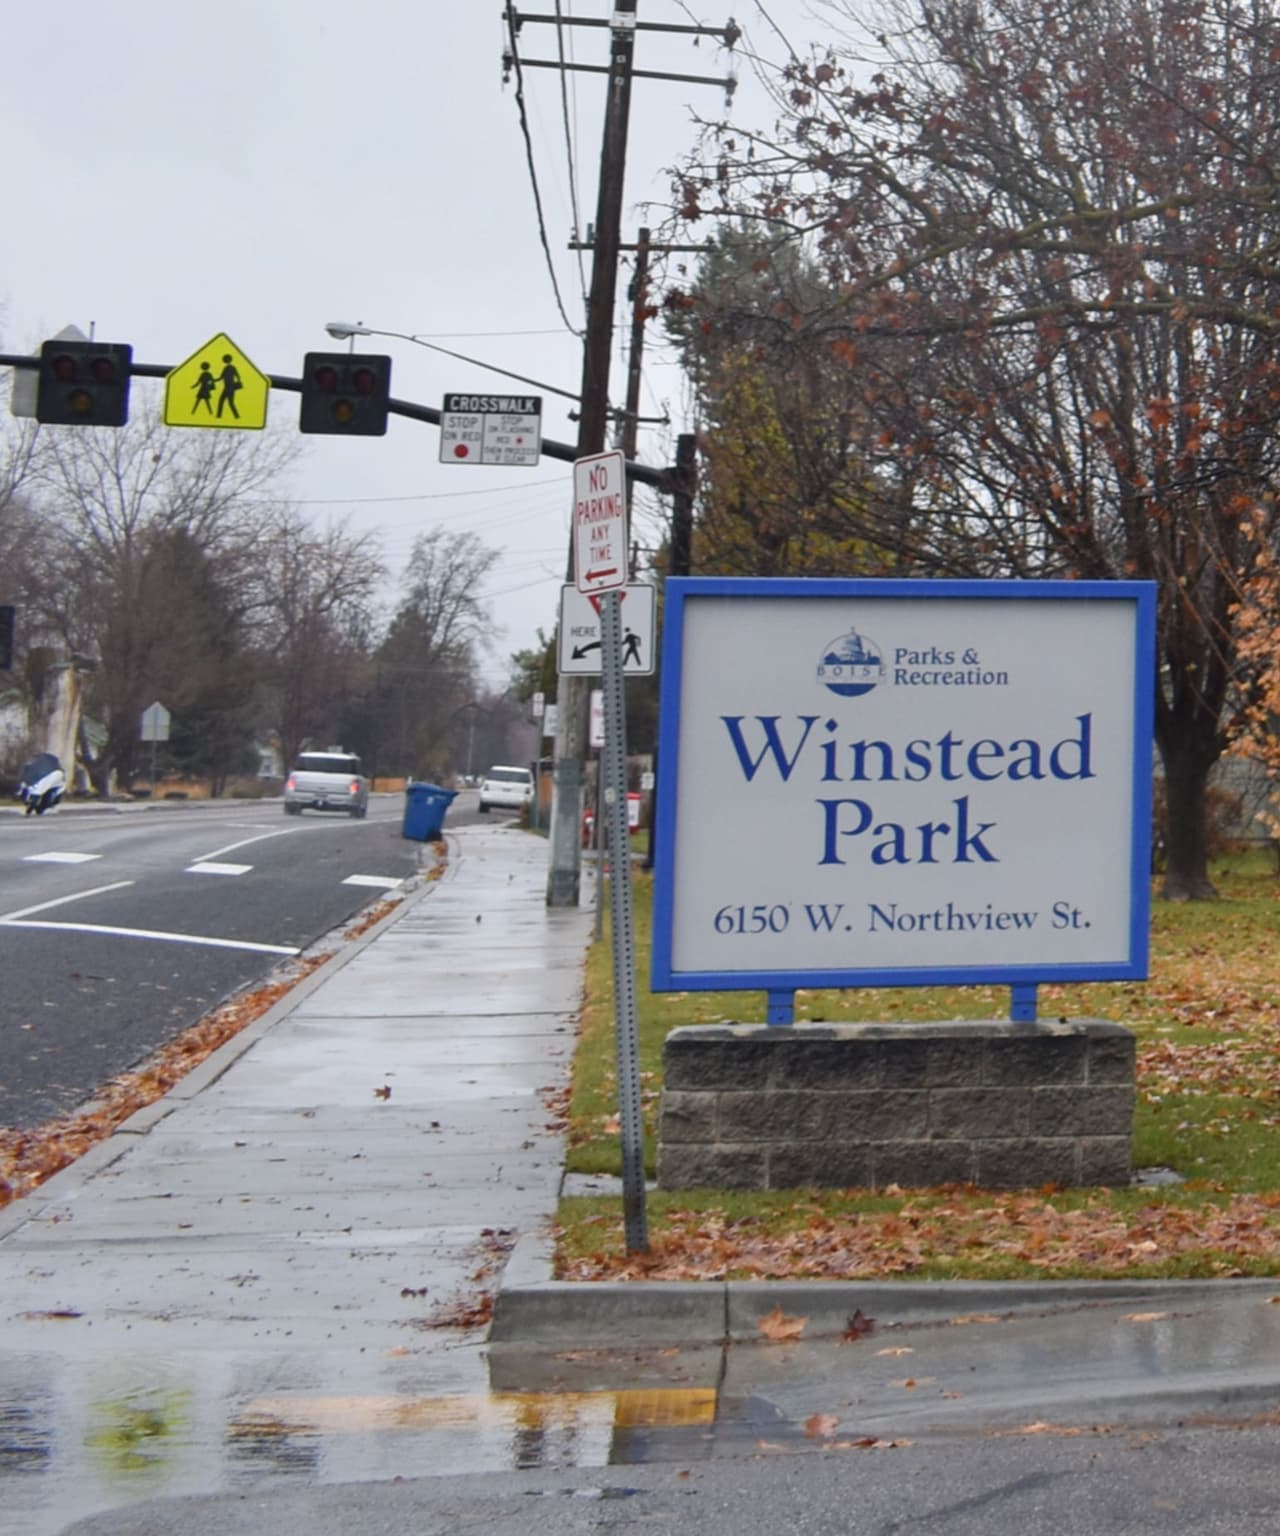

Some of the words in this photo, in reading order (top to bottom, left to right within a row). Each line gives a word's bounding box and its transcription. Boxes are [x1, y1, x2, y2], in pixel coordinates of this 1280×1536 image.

[449, 396, 535, 413] CROSSWALK
[448, 416, 479, 429] STOP
[443, 430, 457, 441] ON
[461, 431, 481, 441] RED
[589, 466, 608, 493] NO
[577, 493, 622, 525] PARKING
[591, 525, 609, 542] ANY
[590, 543, 612, 563] TIME
[570, 626, 597, 638] HERE
[894, 647, 955, 665] Parks
[962, 648, 981, 665] &
[817, 665, 887, 678] BOISE
[893, 667, 1009, 686] Recreation
[719, 712, 1096, 783] Winstead
[816, 795, 1000, 866] Park
[713, 904, 790, 934] 6150
[805, 904, 853, 933] W.
[867, 902, 1038, 932] Northview
[1051, 901, 1092, 930] St.
